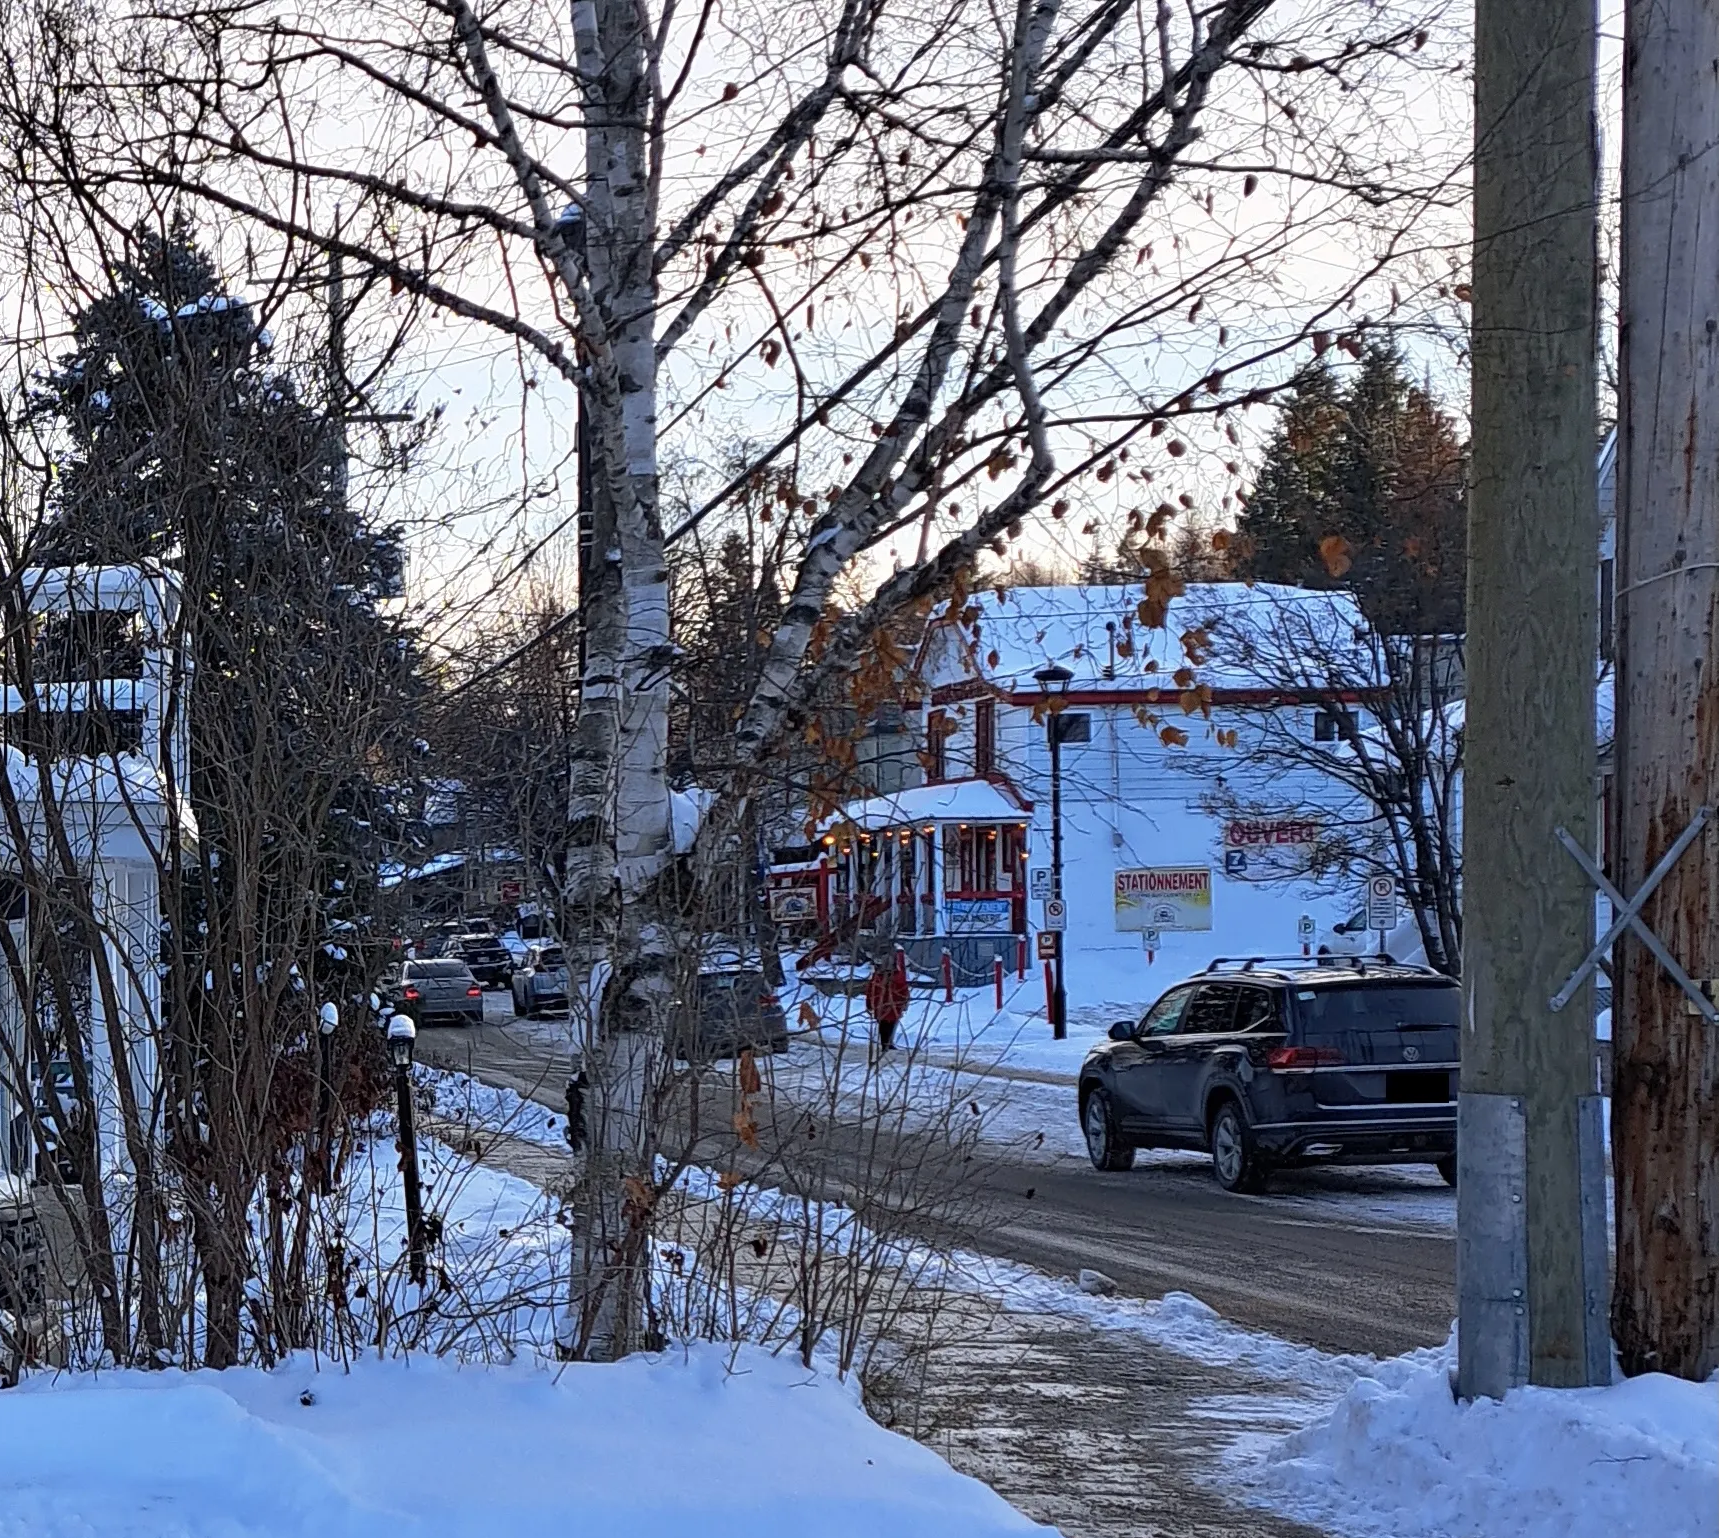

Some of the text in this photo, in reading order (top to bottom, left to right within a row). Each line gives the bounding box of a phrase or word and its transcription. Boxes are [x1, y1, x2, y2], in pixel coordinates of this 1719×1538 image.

[1036, 871, 1047, 882] P
[1117, 873, 1209, 891] STATIONNEMENT
[1303, 923, 1312, 932] P
[1147, 930, 1156, 940] P
